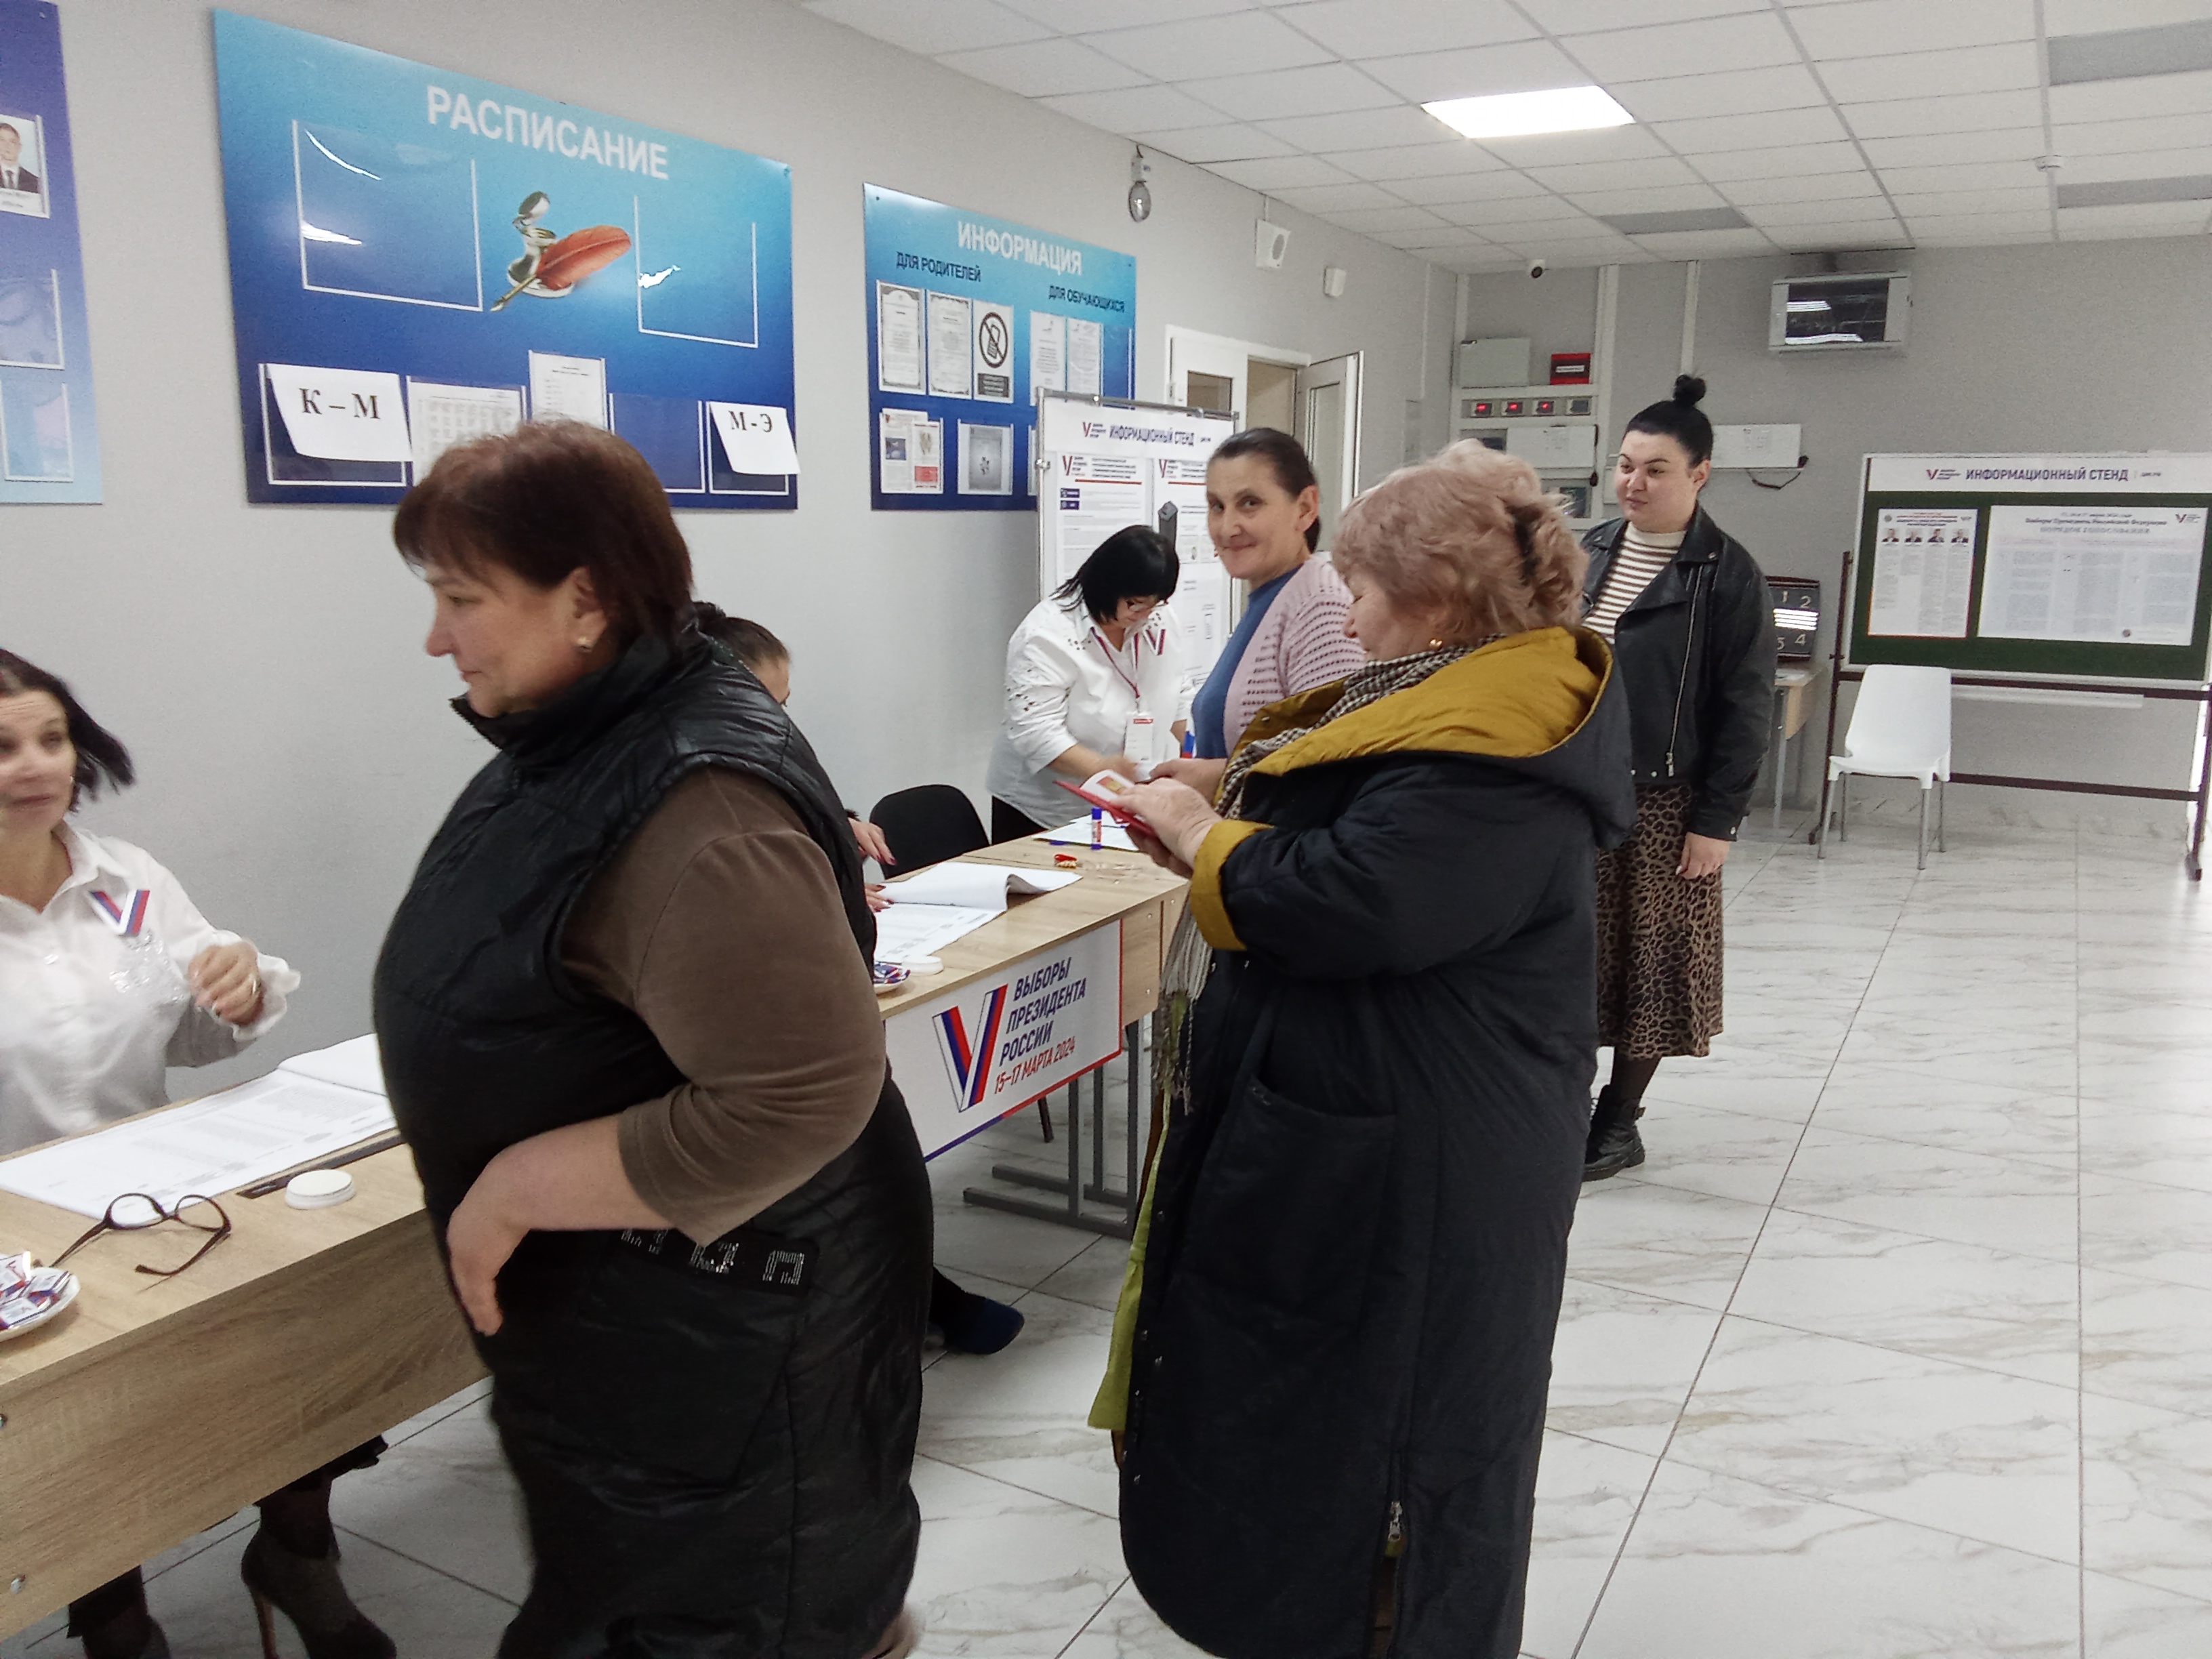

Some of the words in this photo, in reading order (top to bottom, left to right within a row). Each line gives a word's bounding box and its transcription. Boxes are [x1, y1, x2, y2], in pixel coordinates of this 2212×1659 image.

[426, 84, 670, 180] РАСПИСАНИЕ
[896, 251, 919, 270] ДЛЯ
[922, 257, 981, 283] РОДИТЕЛЕЙ
[958, 221, 1083, 276] ИНФОРМАЦИЯ
[1965, 467, 2086, 482] ИНФОРМАЦИОННЫЙ
[2089, 469, 2129, 482] СТЕНД
[1013, 956, 1072, 1002] ВЫБОРЫ
[1006, 977, 1087, 1034] ПРЕЗИДЕНТА
[999, 1020, 1054, 1067] РОССИИ
[1021, 1048, 1054, 1081] МАРТА
[1053, 1036, 1076, 1062] 2024
